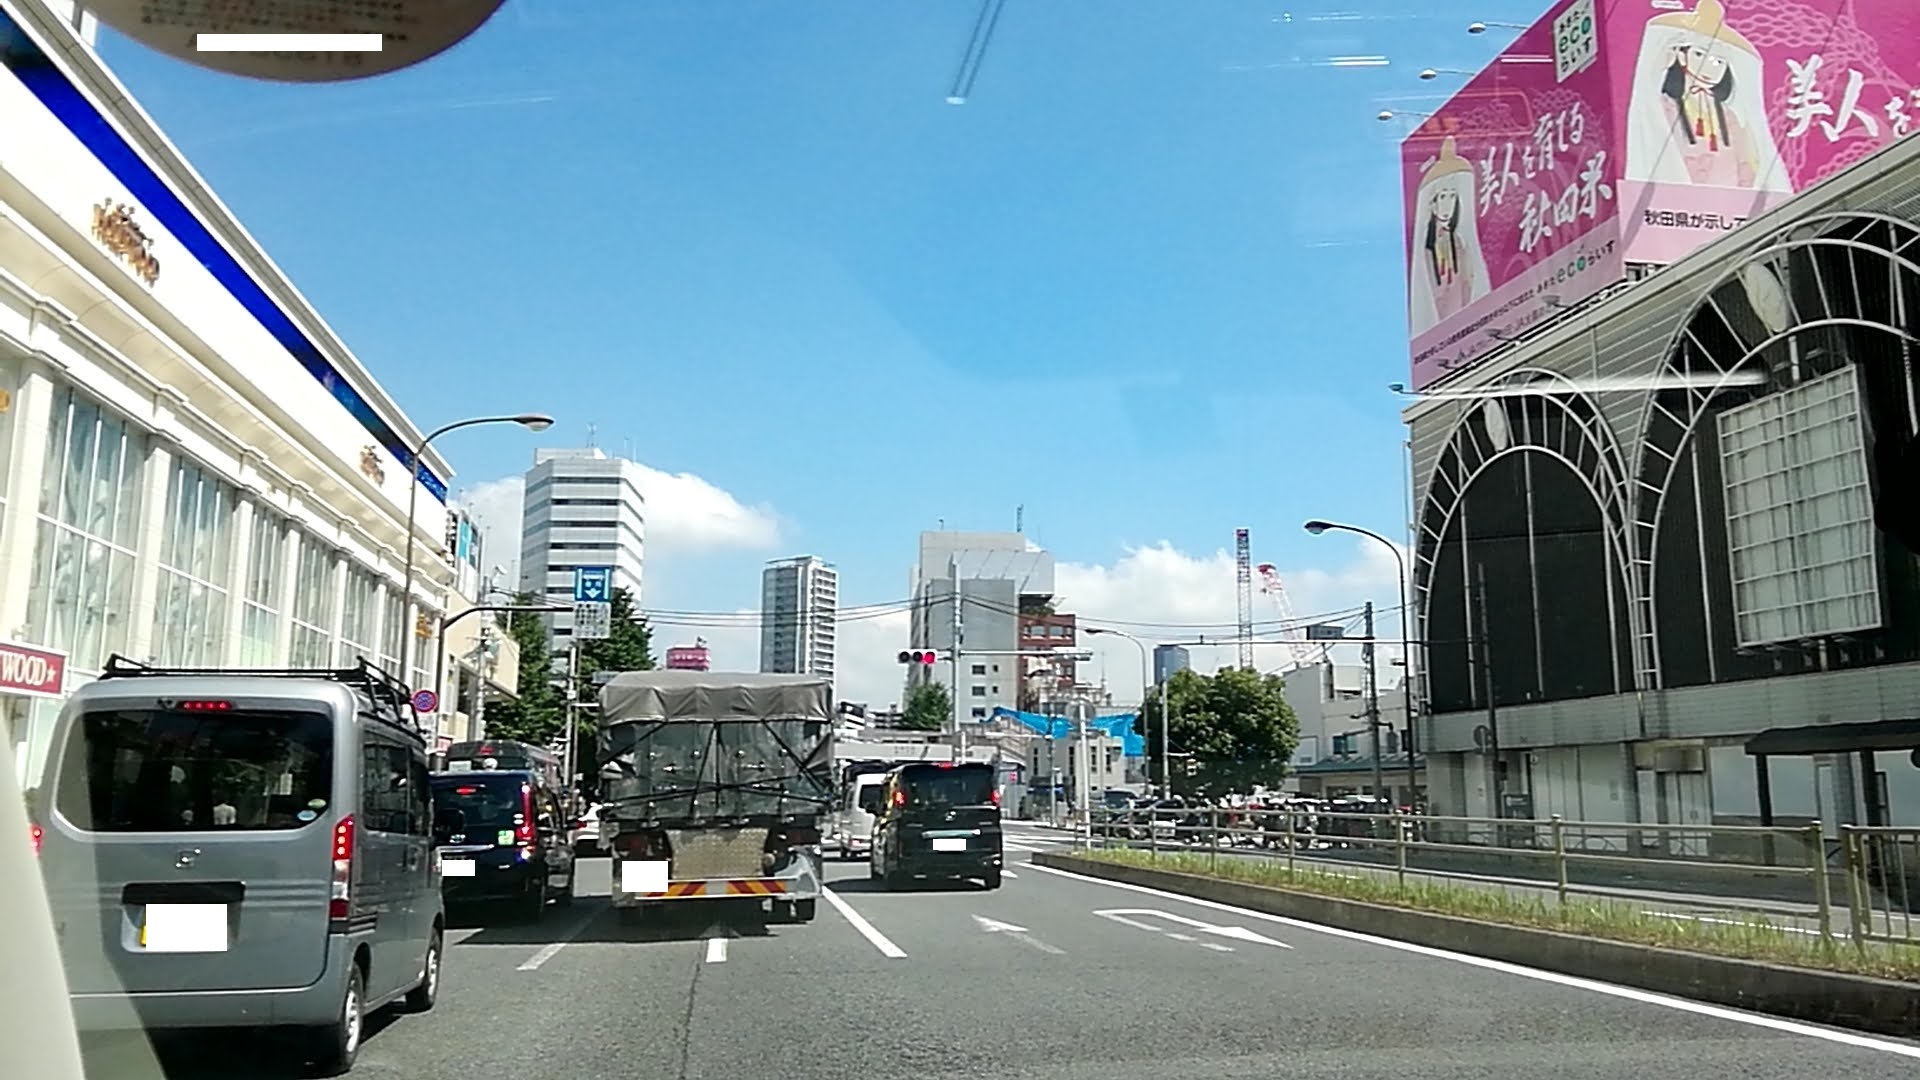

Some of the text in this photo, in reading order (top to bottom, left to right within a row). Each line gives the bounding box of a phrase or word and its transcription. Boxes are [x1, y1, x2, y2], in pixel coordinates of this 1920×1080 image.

[1786, 54, 1920, 142] 美人を
[1518, 150, 1614, 254] 秋田米
